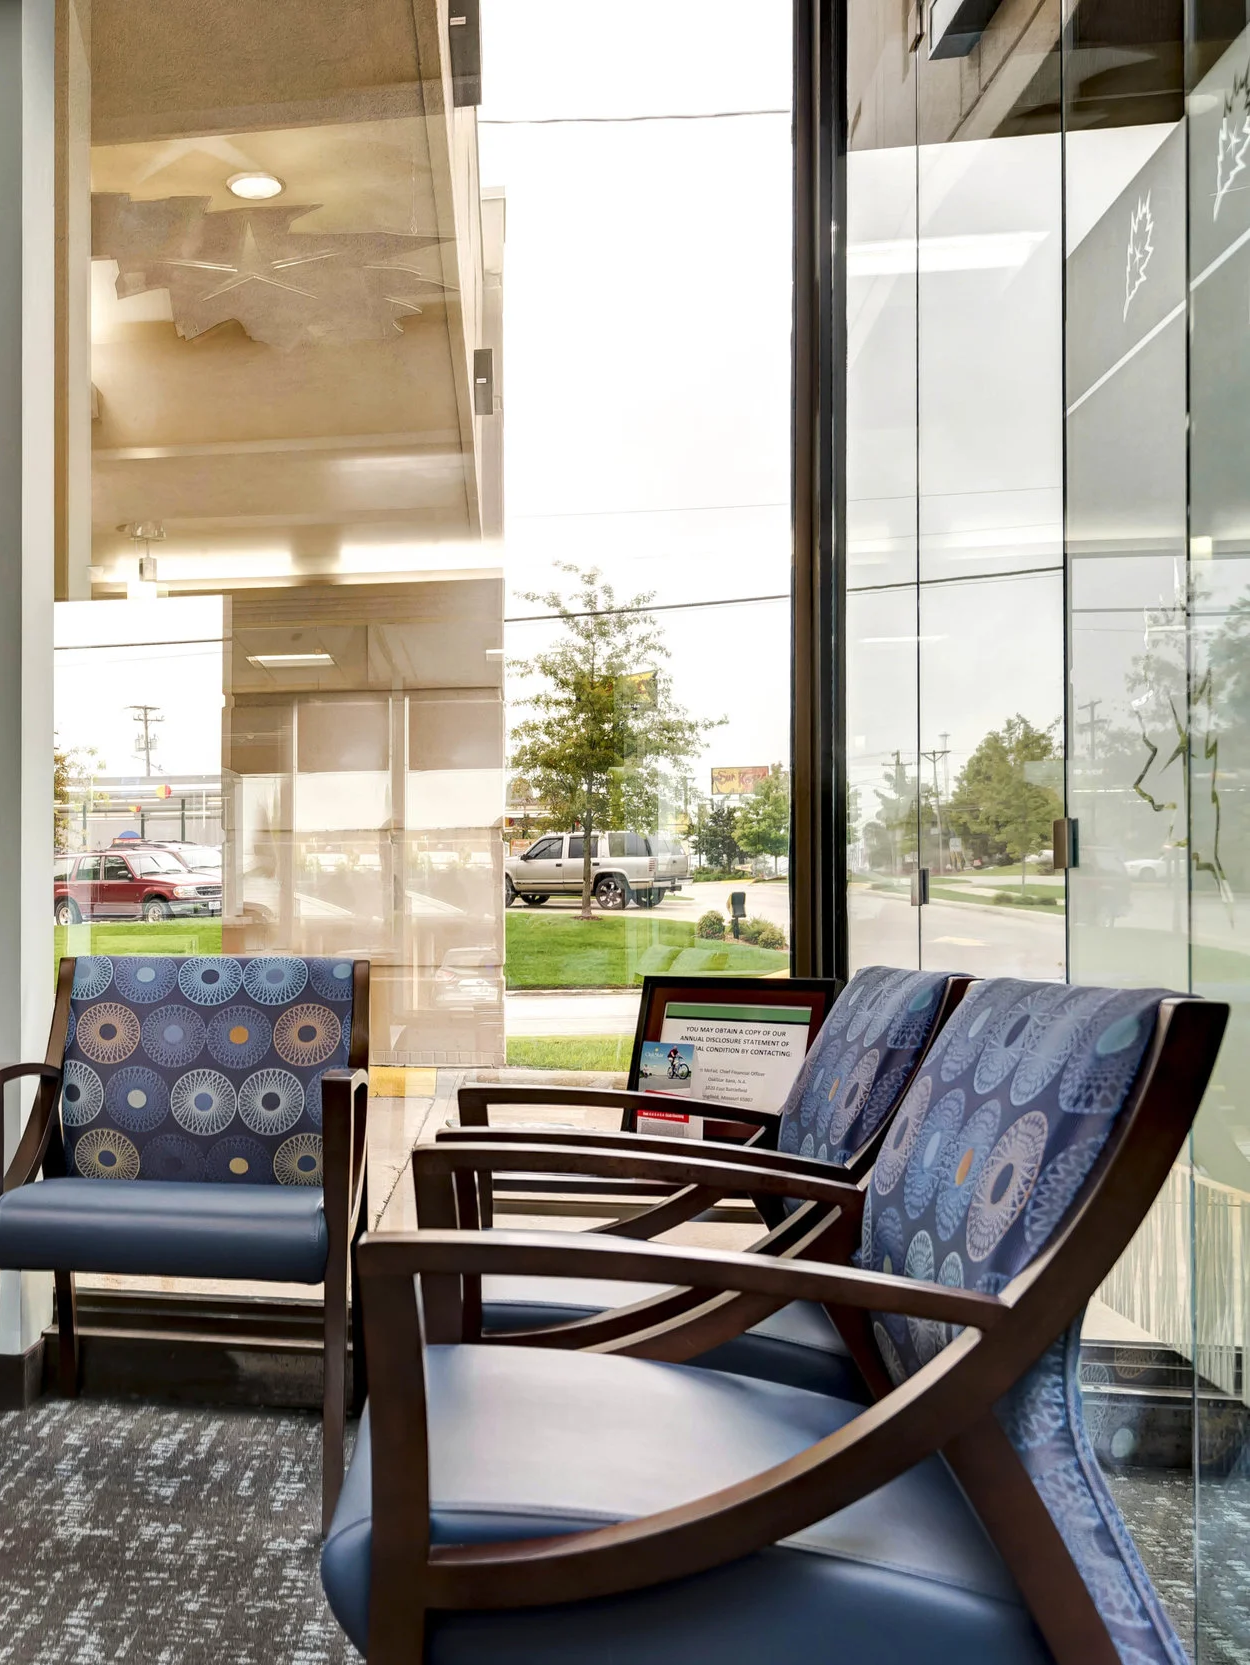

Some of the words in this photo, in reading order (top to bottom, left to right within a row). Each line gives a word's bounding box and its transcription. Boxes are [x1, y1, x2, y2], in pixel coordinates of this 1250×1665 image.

[705, 1037, 742, 1045] DISCLOSURE
[742, 1038, 780, 1046] STATEMENT
[705, 1046, 740, 1054] CONDITION
